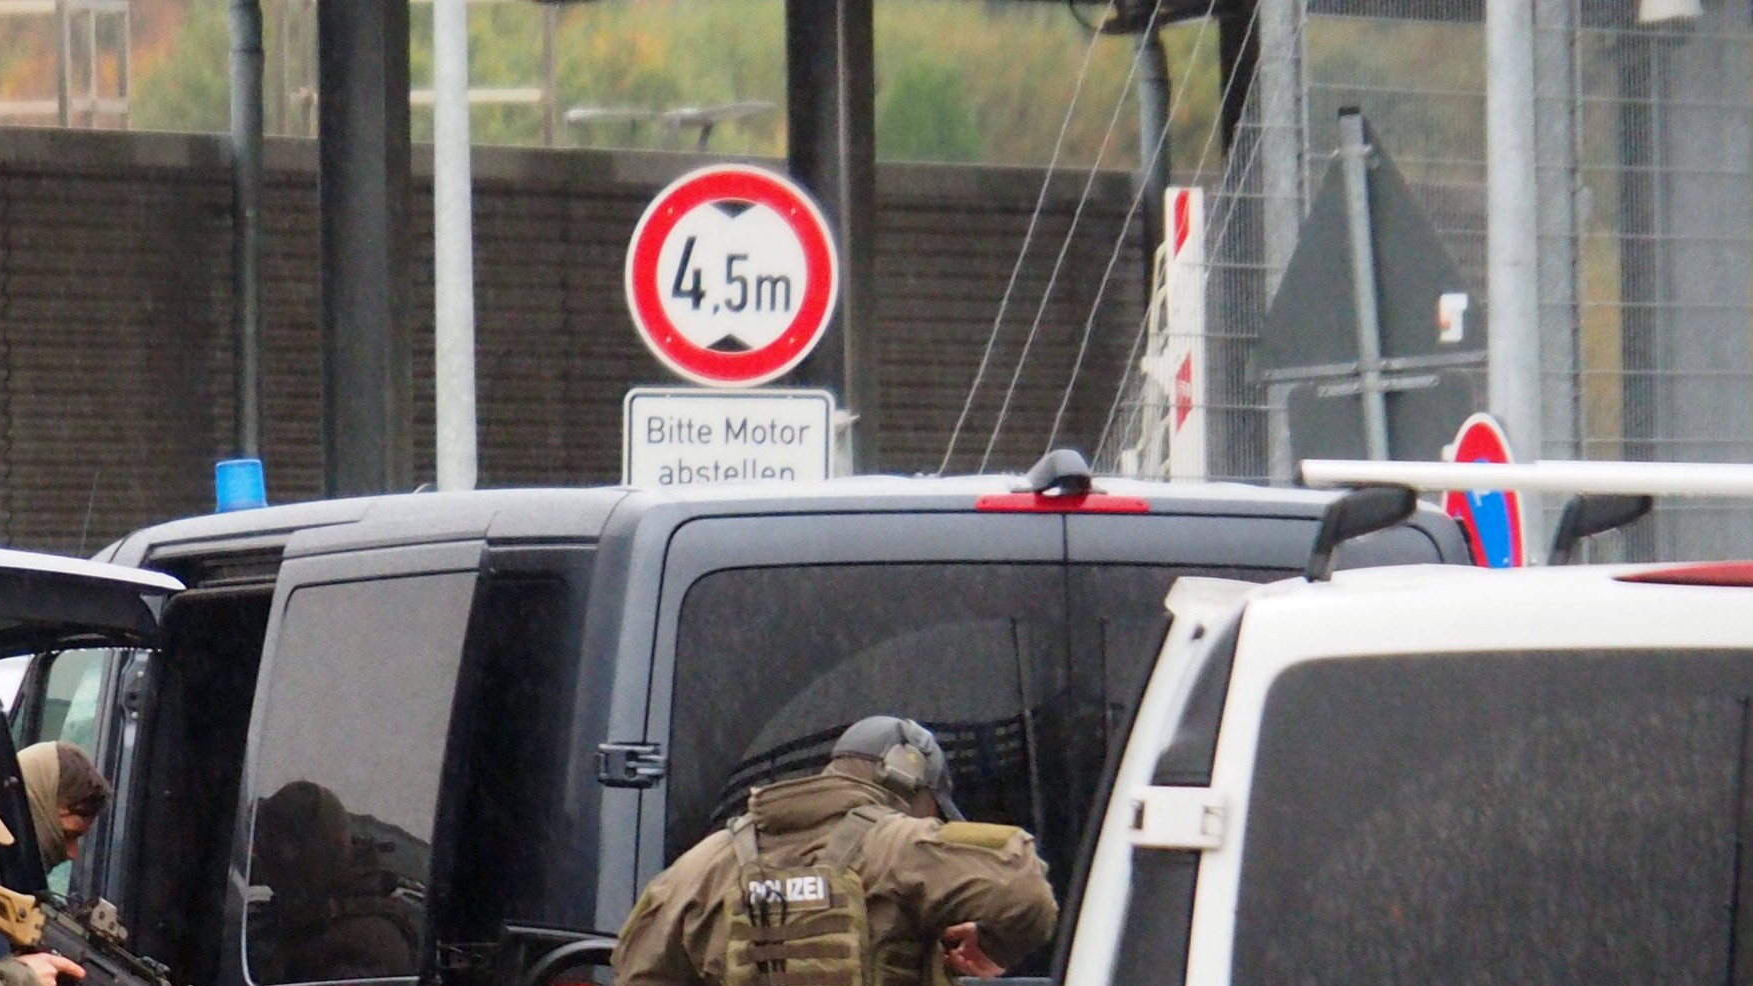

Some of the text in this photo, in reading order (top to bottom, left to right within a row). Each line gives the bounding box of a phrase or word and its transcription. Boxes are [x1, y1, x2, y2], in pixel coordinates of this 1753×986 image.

[671, 235, 792, 315] 4,5m
[647, 415, 811, 446] Bitte Motor
[658, 457, 795, 486] abstellen
